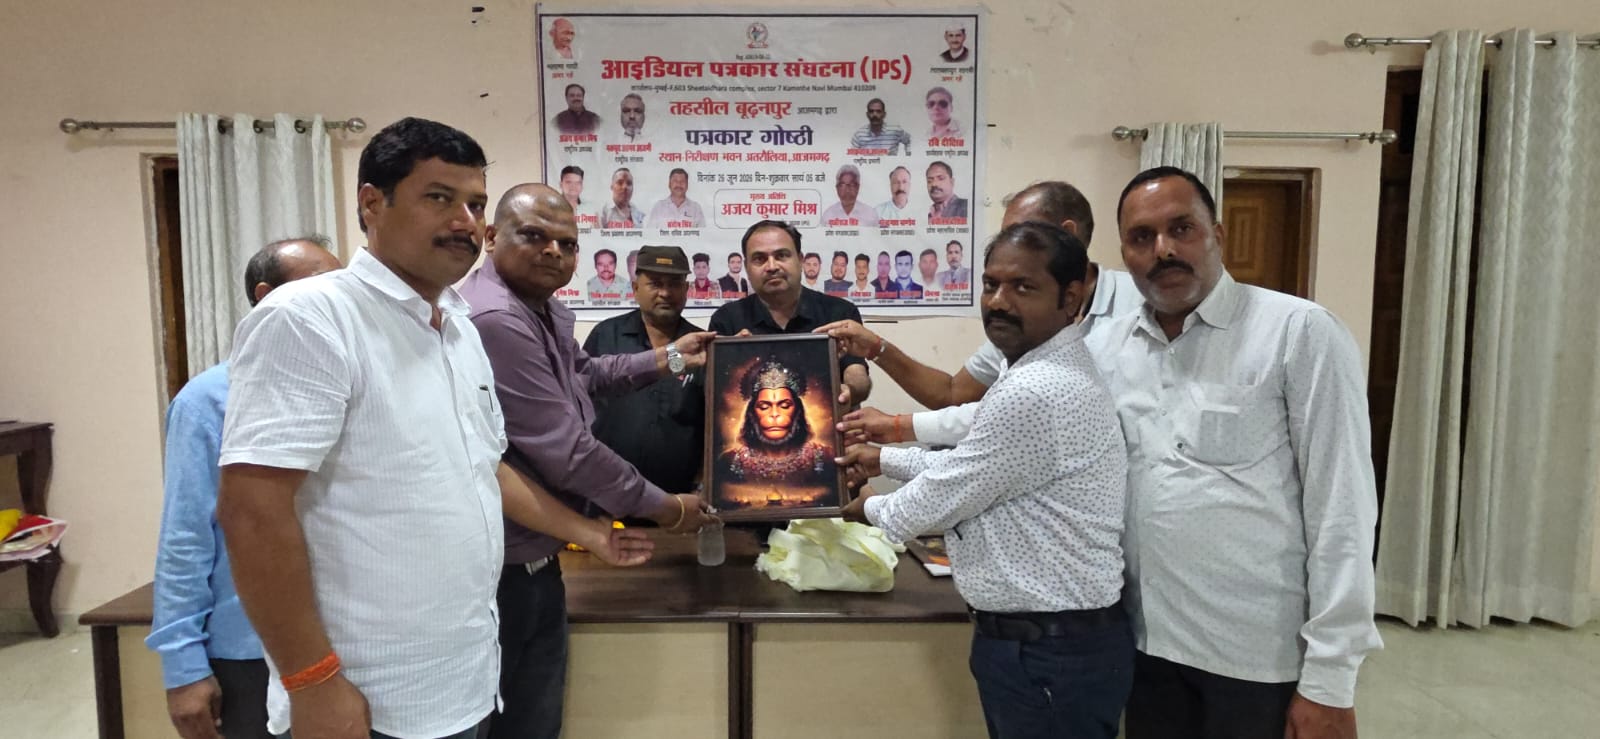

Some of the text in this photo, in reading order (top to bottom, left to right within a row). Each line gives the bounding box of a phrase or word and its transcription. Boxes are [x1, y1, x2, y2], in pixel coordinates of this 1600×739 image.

[601, 54, 912, 84] आइडियल पत्रकार संघटना (IPS)
[670, 97, 729, 115] तहसील
[735, 101, 792, 119] बूढ़नपुर
[685, 125, 814, 146] पत्रकार गोष्ठी
[722, 152, 743, 162] भवन
[697, 171, 716, 182] दिनांक
[727, 174, 738, 185] जून
[721, 200, 818, 218] अजय कुमार मिश्र
